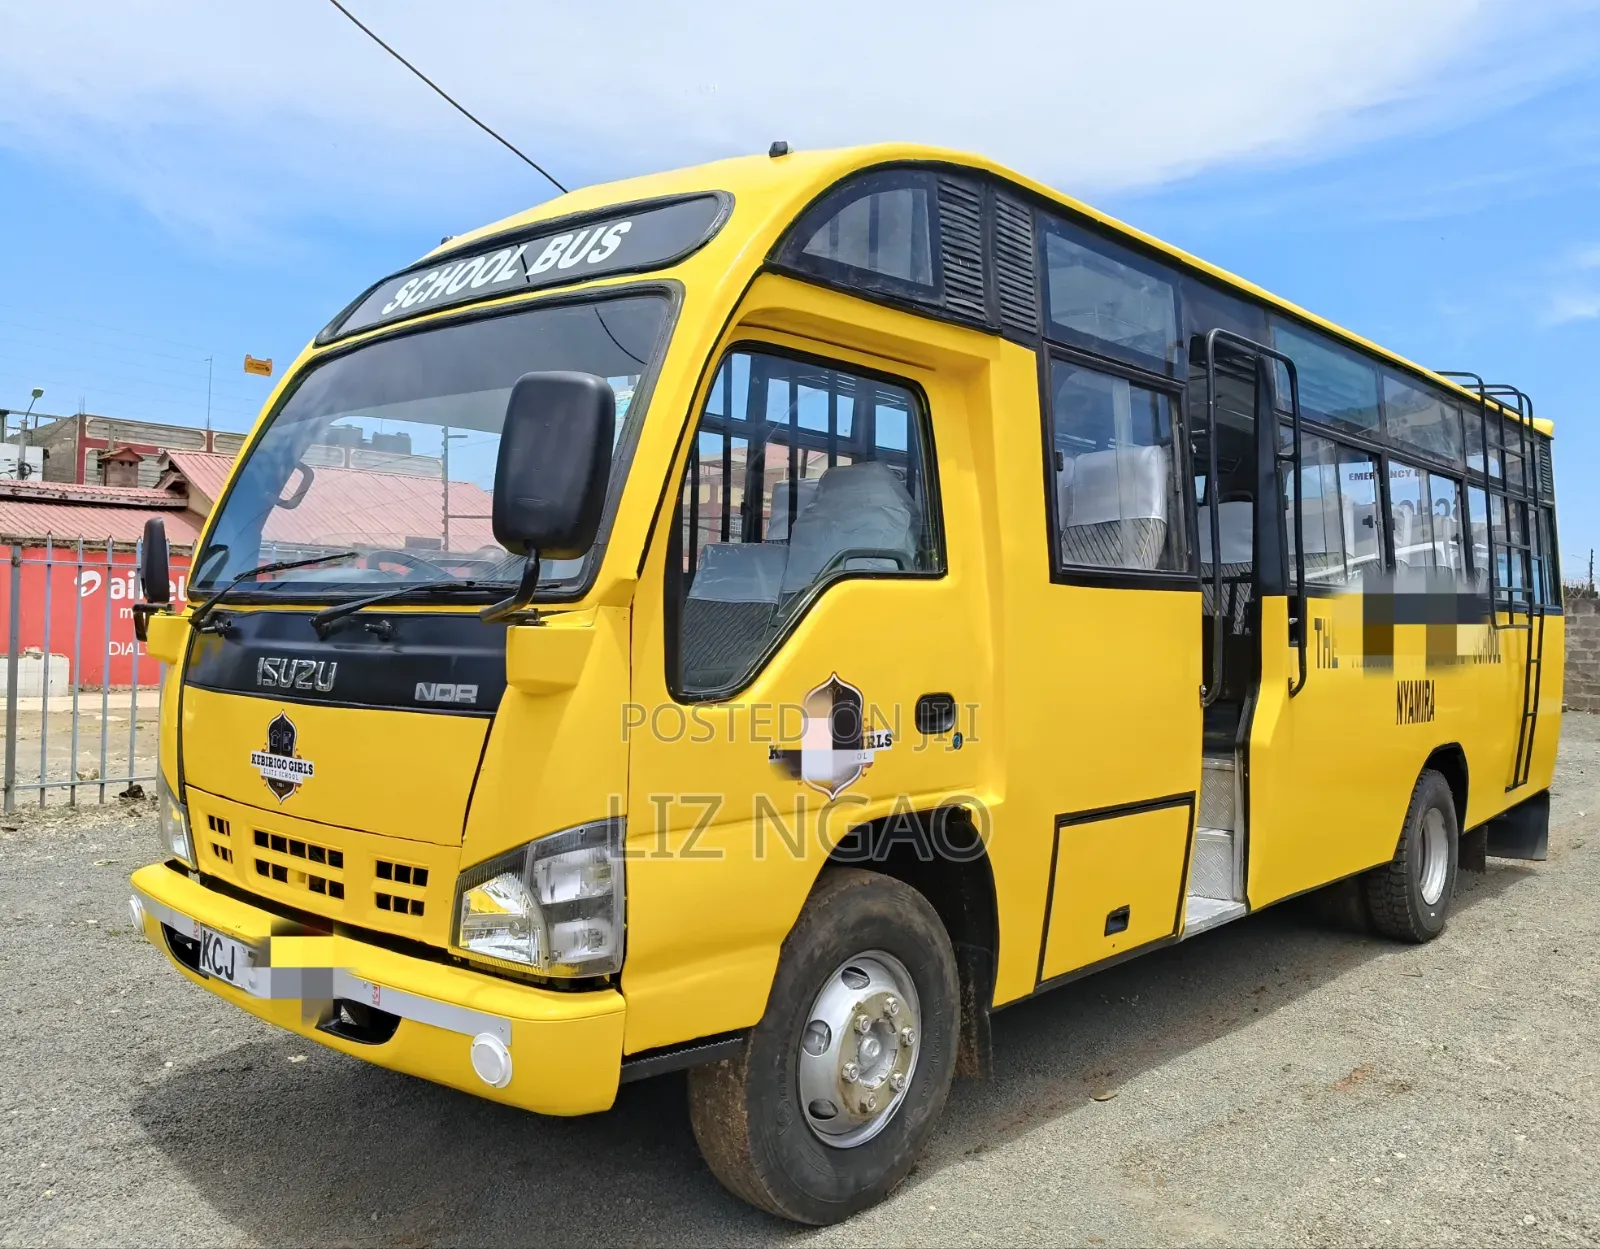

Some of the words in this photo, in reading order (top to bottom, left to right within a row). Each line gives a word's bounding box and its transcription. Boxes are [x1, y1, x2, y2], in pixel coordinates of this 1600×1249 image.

[381, 245, 529, 315] SCHOOL
[525, 221, 632, 277] BUS
[1348, 469, 1412, 481] EMERNCY
[109, 641, 145, 656] DIAL
[256, 656, 337, 692] ISUZU
[414, 682, 479, 703] NQR
[1396, 679, 1435, 725] NYAMIRA
[251, 753, 287, 770] KEBIRIGO
[288, 760, 314, 776] GIRLS
[201, 929, 236, 981] KCJ
